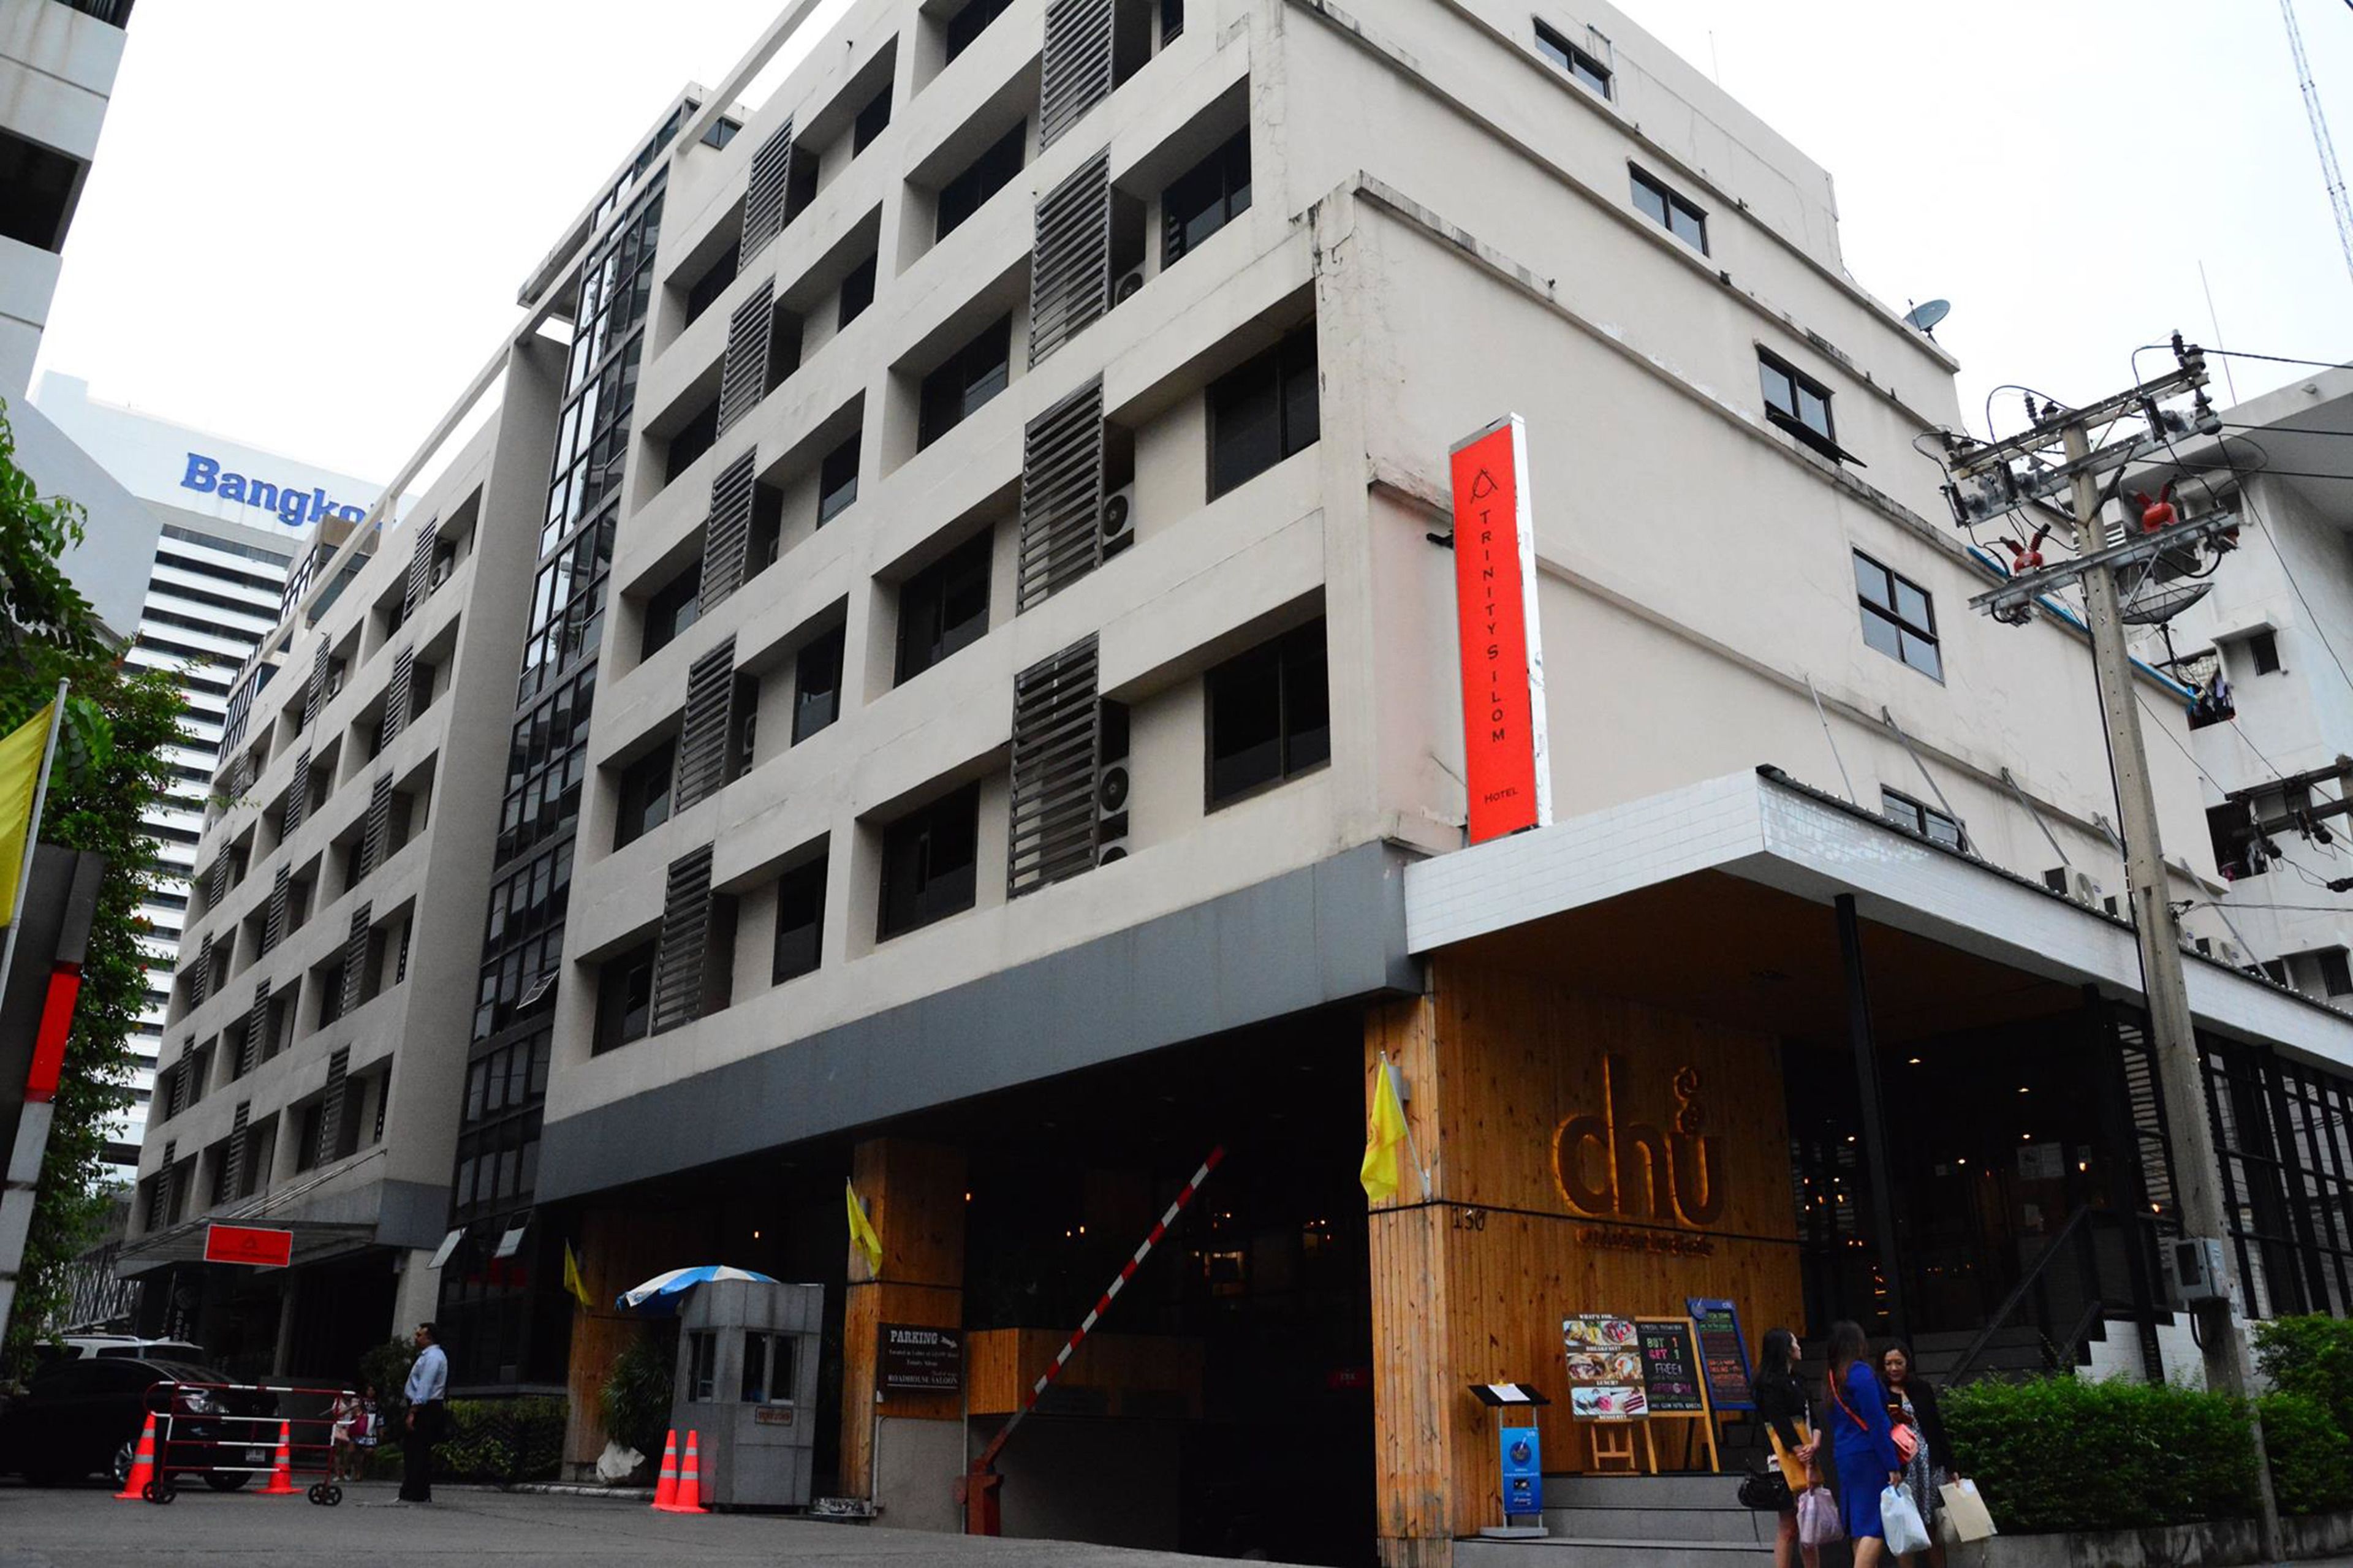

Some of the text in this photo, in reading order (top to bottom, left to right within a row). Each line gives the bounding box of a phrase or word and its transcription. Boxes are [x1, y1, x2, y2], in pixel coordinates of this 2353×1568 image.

[180, 452, 382, 530] Bangko
[1479, 509, 1505, 743] TRINITY SILOM
[1483, 786, 1518, 804] HOTEL
[890, 1330, 938, 1344] PARKING
[1646, 1336, 1678, 1348] BUY 1
[1648, 1349, 1680, 1360] GET 1
